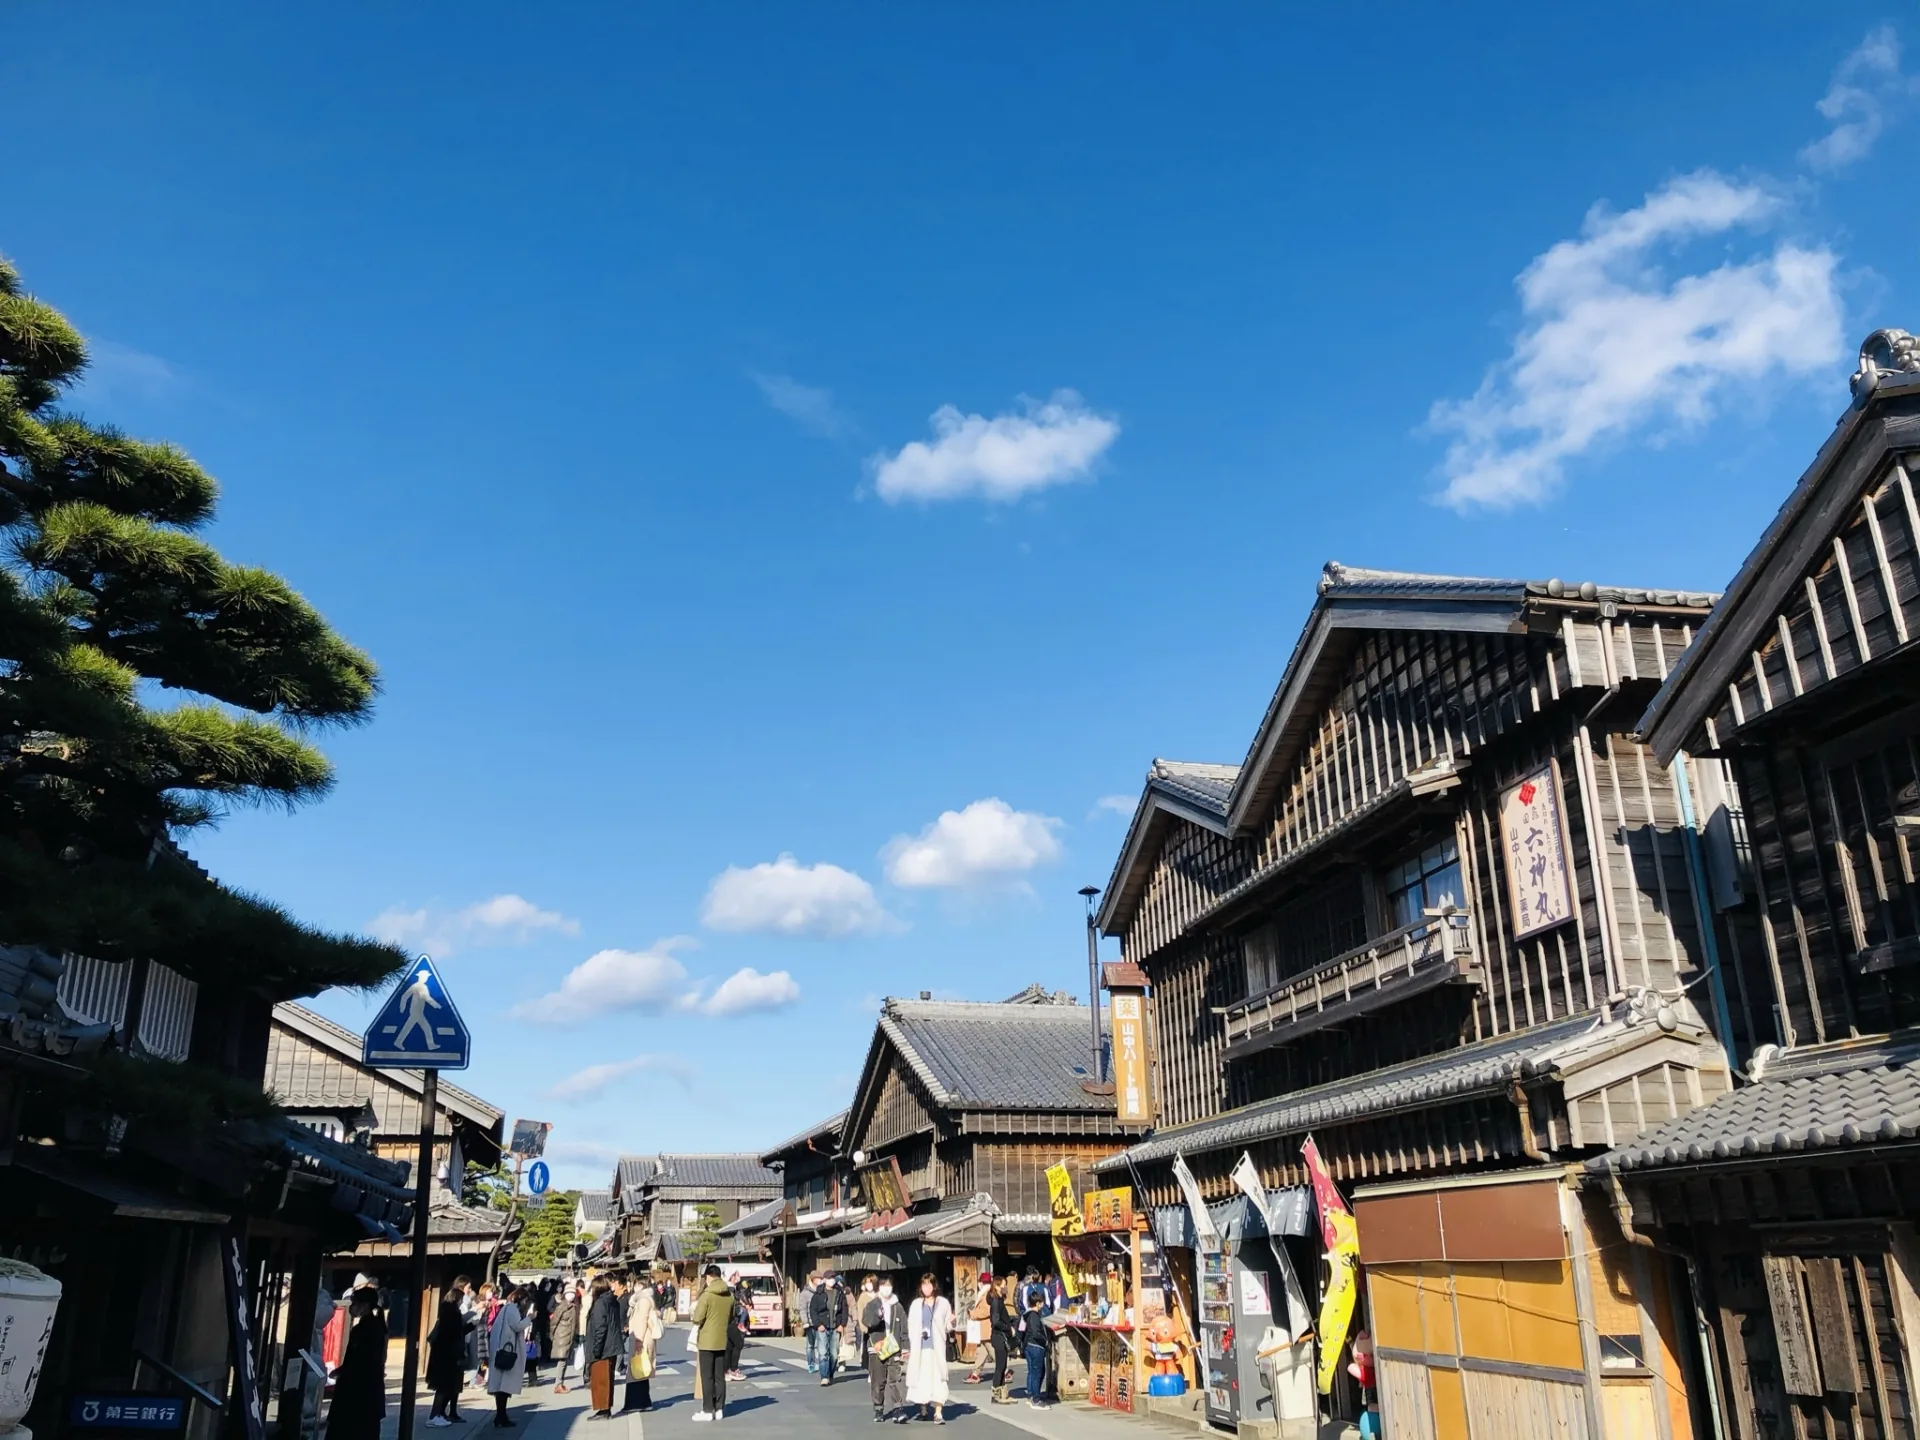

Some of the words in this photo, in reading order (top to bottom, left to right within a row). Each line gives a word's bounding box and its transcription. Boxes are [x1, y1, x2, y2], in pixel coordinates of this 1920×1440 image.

[1509, 827, 1531, 929] 山中ハート薬局
[1524, 826, 1555, 924] 六神丸
[105, 1406, 176, 1421] 第三銀行
